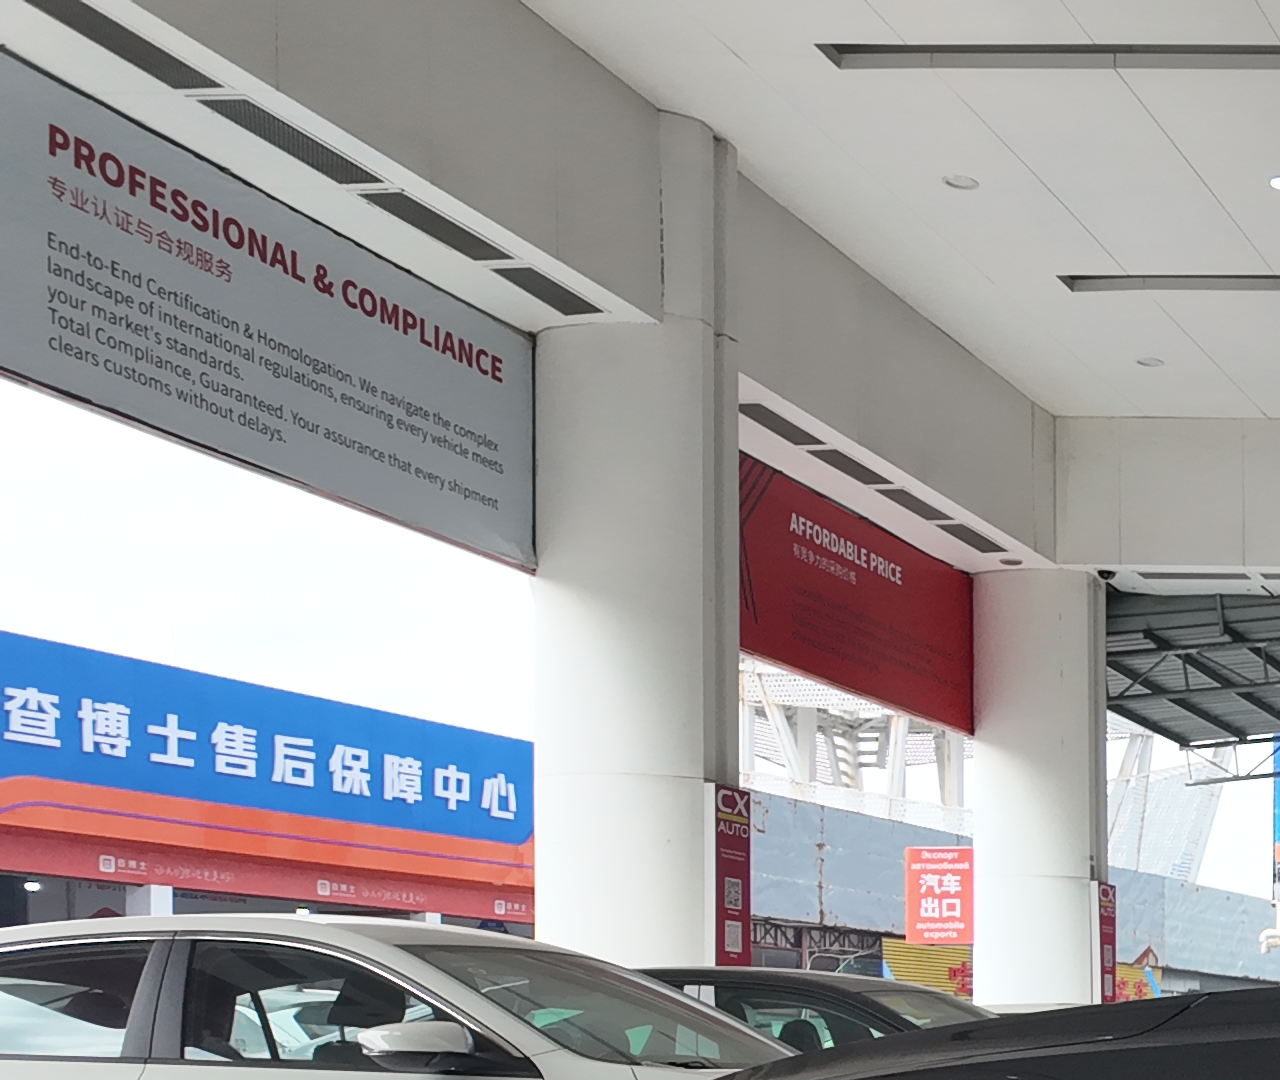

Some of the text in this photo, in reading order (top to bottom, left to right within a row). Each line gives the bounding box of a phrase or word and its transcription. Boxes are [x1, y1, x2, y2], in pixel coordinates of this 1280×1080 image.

[47, 175, 233, 283] 专业认证与合规服务
[48, 123, 503, 384] PROFESSIONAL & COMPLIANCE
[47, 284, 245, 382] your market's standards.
[47, 255, 504, 475] landscape of international regulations, ensuring every vehicle meets
[48, 232, 499, 452] End-to-End Certification & Homologation. We navigate the complex
[47, 306, 499, 511] Total Compliance, Guaranteed. Your assurance that every shipment
[48, 334, 287, 443] clears customs without delays.
[789, 512, 903, 585] AFFORDABLE PRICE
[3, 686, 517, 820] 查博士售后保障中心
[717, 789, 749, 817] CX
[717, 821, 749, 838] AUTO
[916, 921, 965, 930] automobile
[919, 873, 962, 894] 汽车
[920, 897, 961, 918] 出口
[1100, 885, 1115, 902] CX
[923, 930, 958, 940] exports
